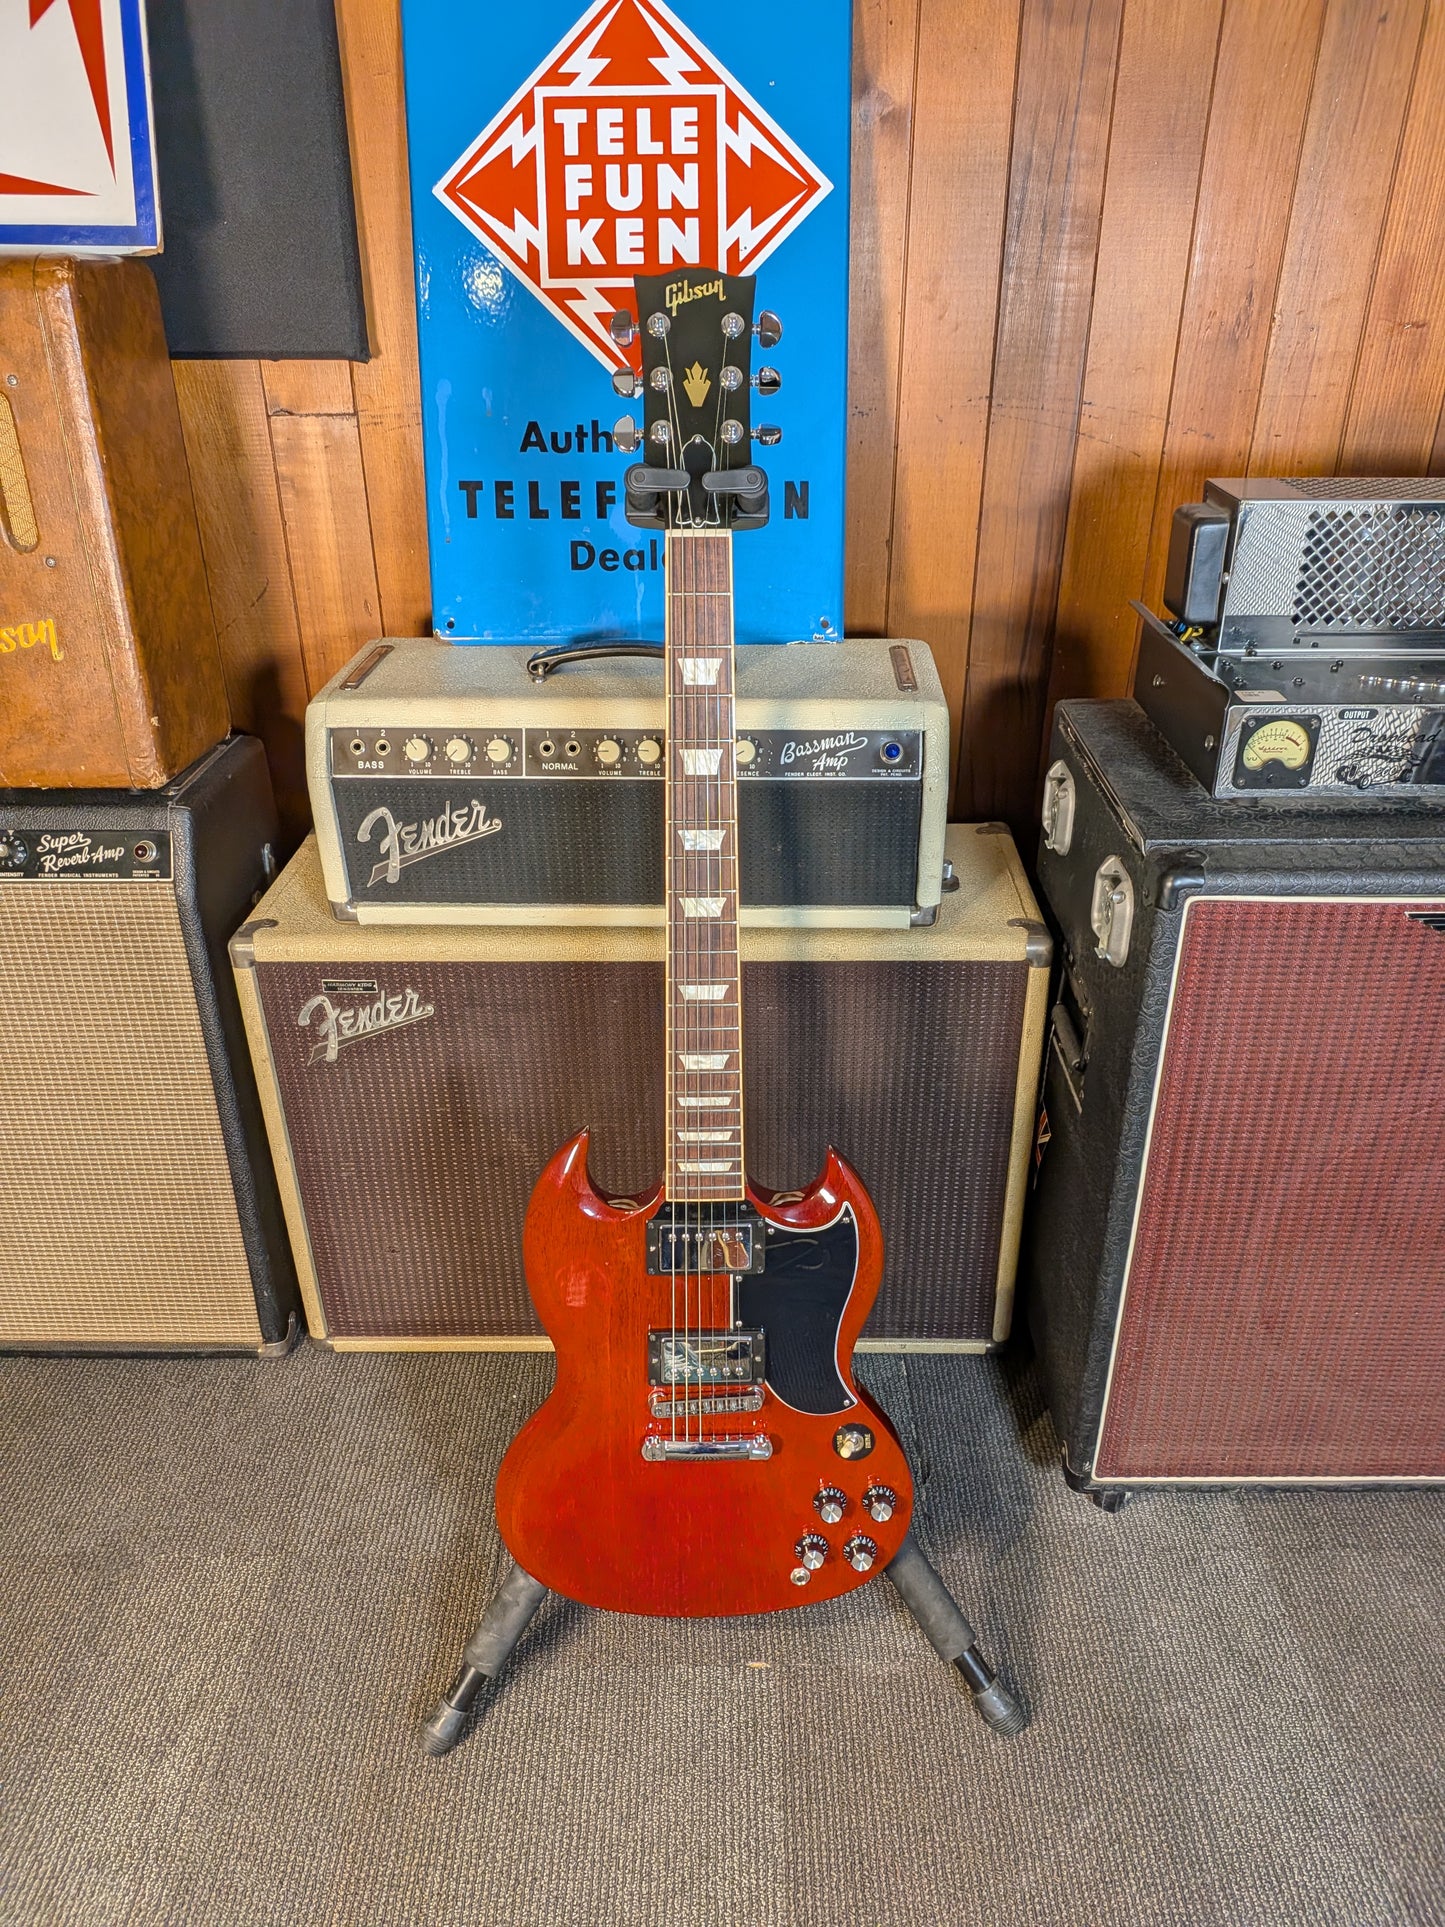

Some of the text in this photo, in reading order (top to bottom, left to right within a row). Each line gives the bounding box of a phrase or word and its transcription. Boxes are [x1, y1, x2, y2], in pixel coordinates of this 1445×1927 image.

[553, 106, 698, 156] TELE
[564, 162, 699, 212] FUN
[566, 216, 700, 266] KEN
[665, 278, 726, 317] Gibson
[519, 419, 614, 454] Auth
[458, 480, 810, 520] TELEFN
[570, 540, 666, 572] Deal
[0, 618, 64, 662] son
[780, 731, 868, 764] Bassman
[36, 832, 91, 853] Super
[357, 799, 502, 888] Fender
[298, 988, 434, 1066] Fender
